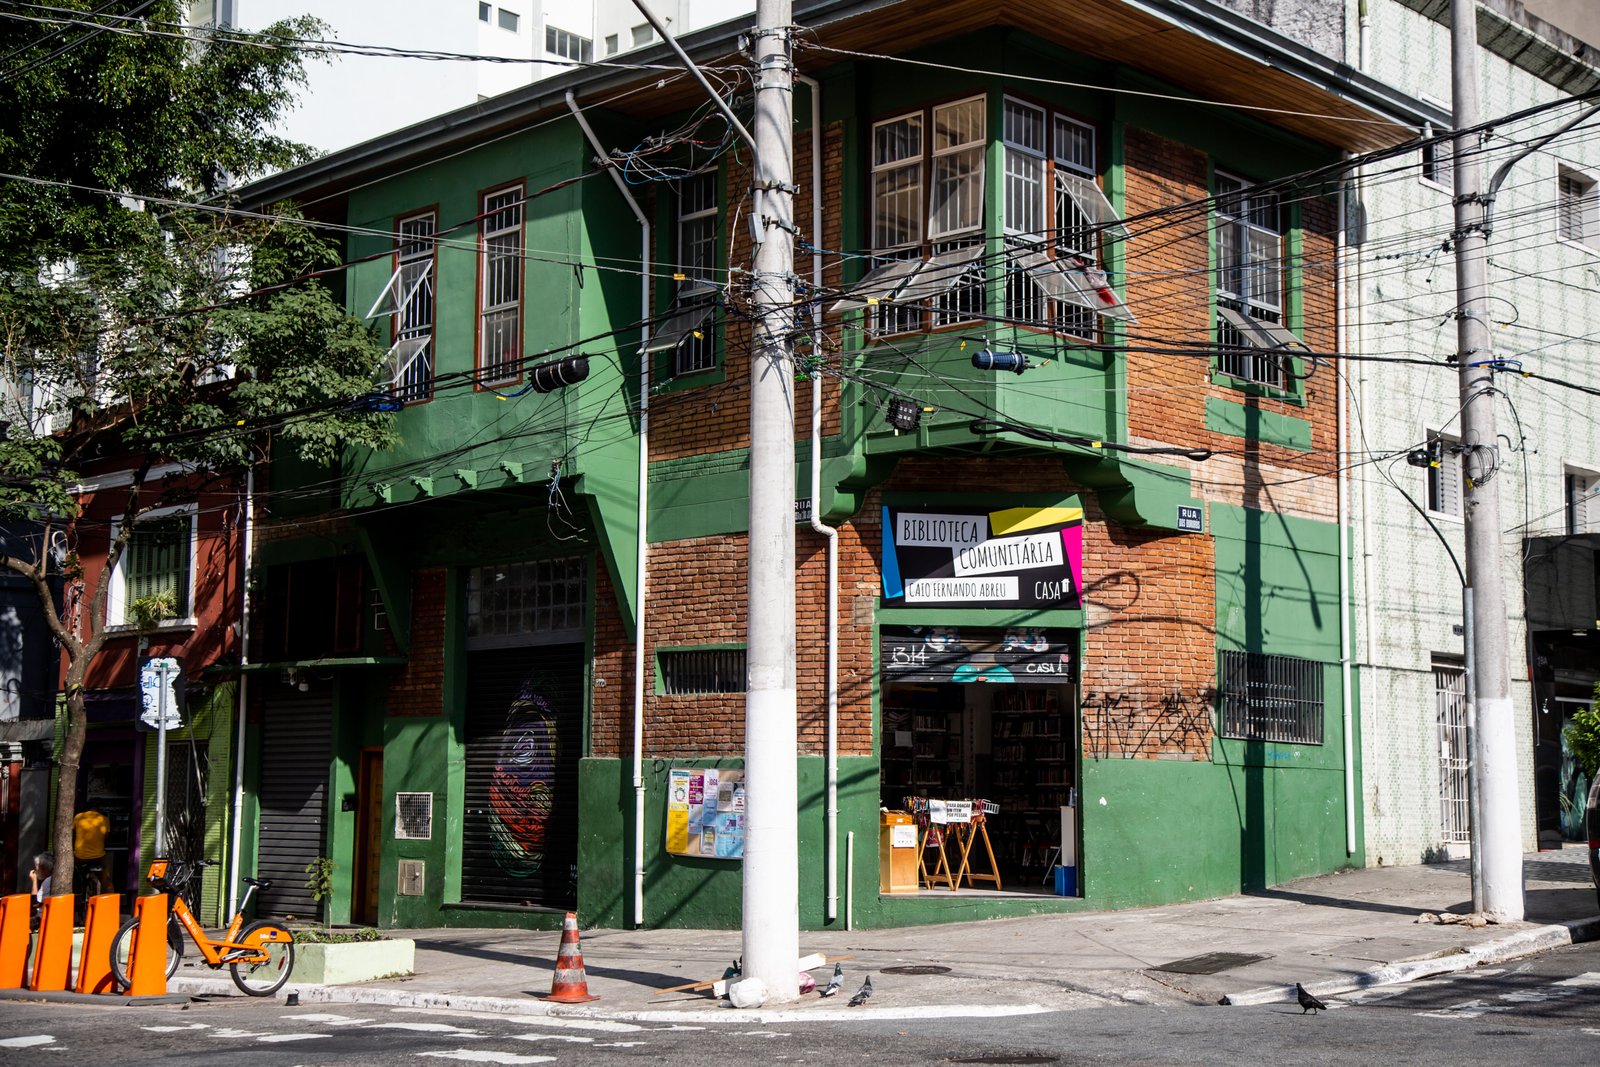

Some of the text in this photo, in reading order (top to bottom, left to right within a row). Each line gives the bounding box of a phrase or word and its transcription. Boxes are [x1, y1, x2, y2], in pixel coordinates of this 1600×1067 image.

[1182, 509, 1197, 518] RUA
[903, 519, 978, 543] BIBLIOTECA
[960, 537, 1053, 569] COMUNITÁRIA
[909, 582, 1006, 598] CAIO FERNANDO ABREU
[1035, 581, 1061, 600] CASA
[1026, 663, 1055, 673] CASA
